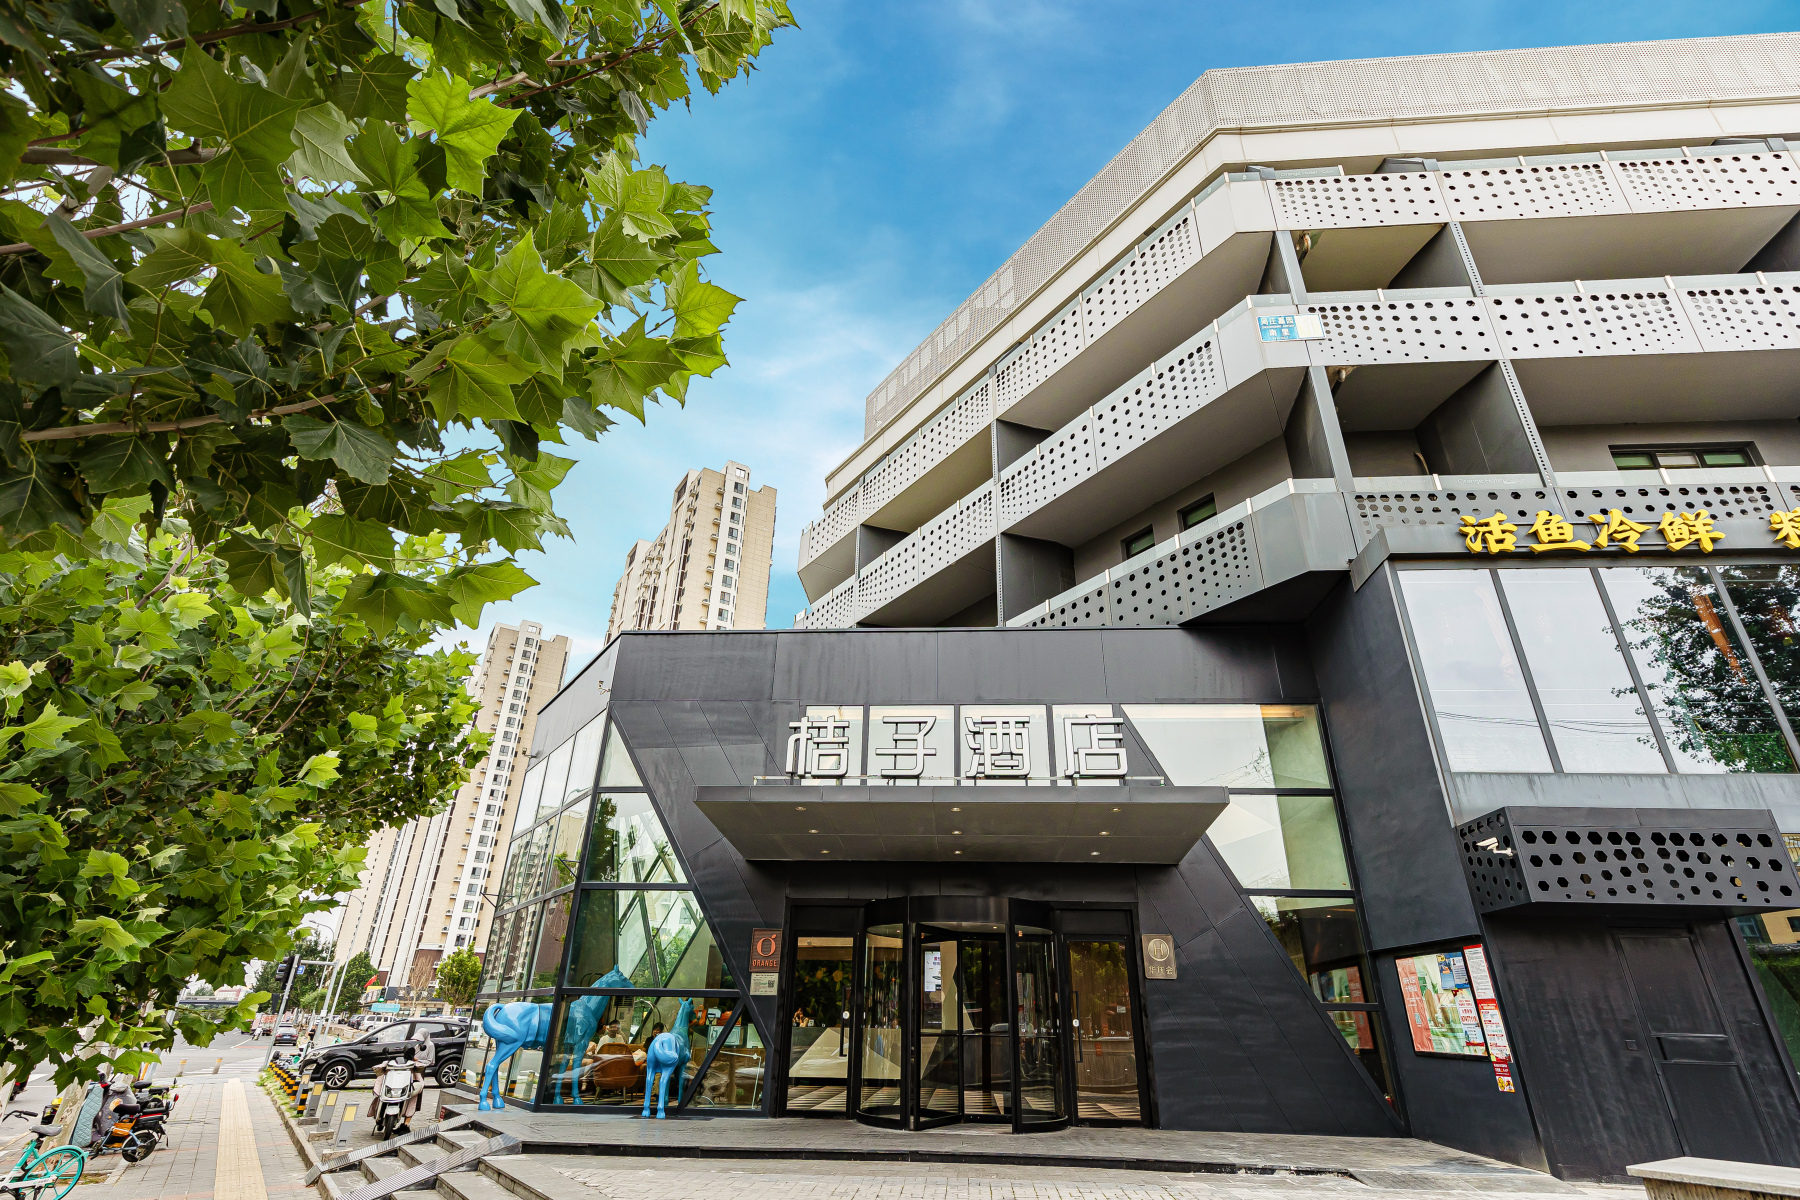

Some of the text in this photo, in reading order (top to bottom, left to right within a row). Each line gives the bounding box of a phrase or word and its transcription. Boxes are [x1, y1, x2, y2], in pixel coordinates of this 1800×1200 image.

[1459, 508, 1726, 555] 活鱼冷鲜
[785, 714, 1129, 778] 桔子酒店
[752, 959, 778, 967] ORANGE
[1148, 965, 1174, 975] 华住会
